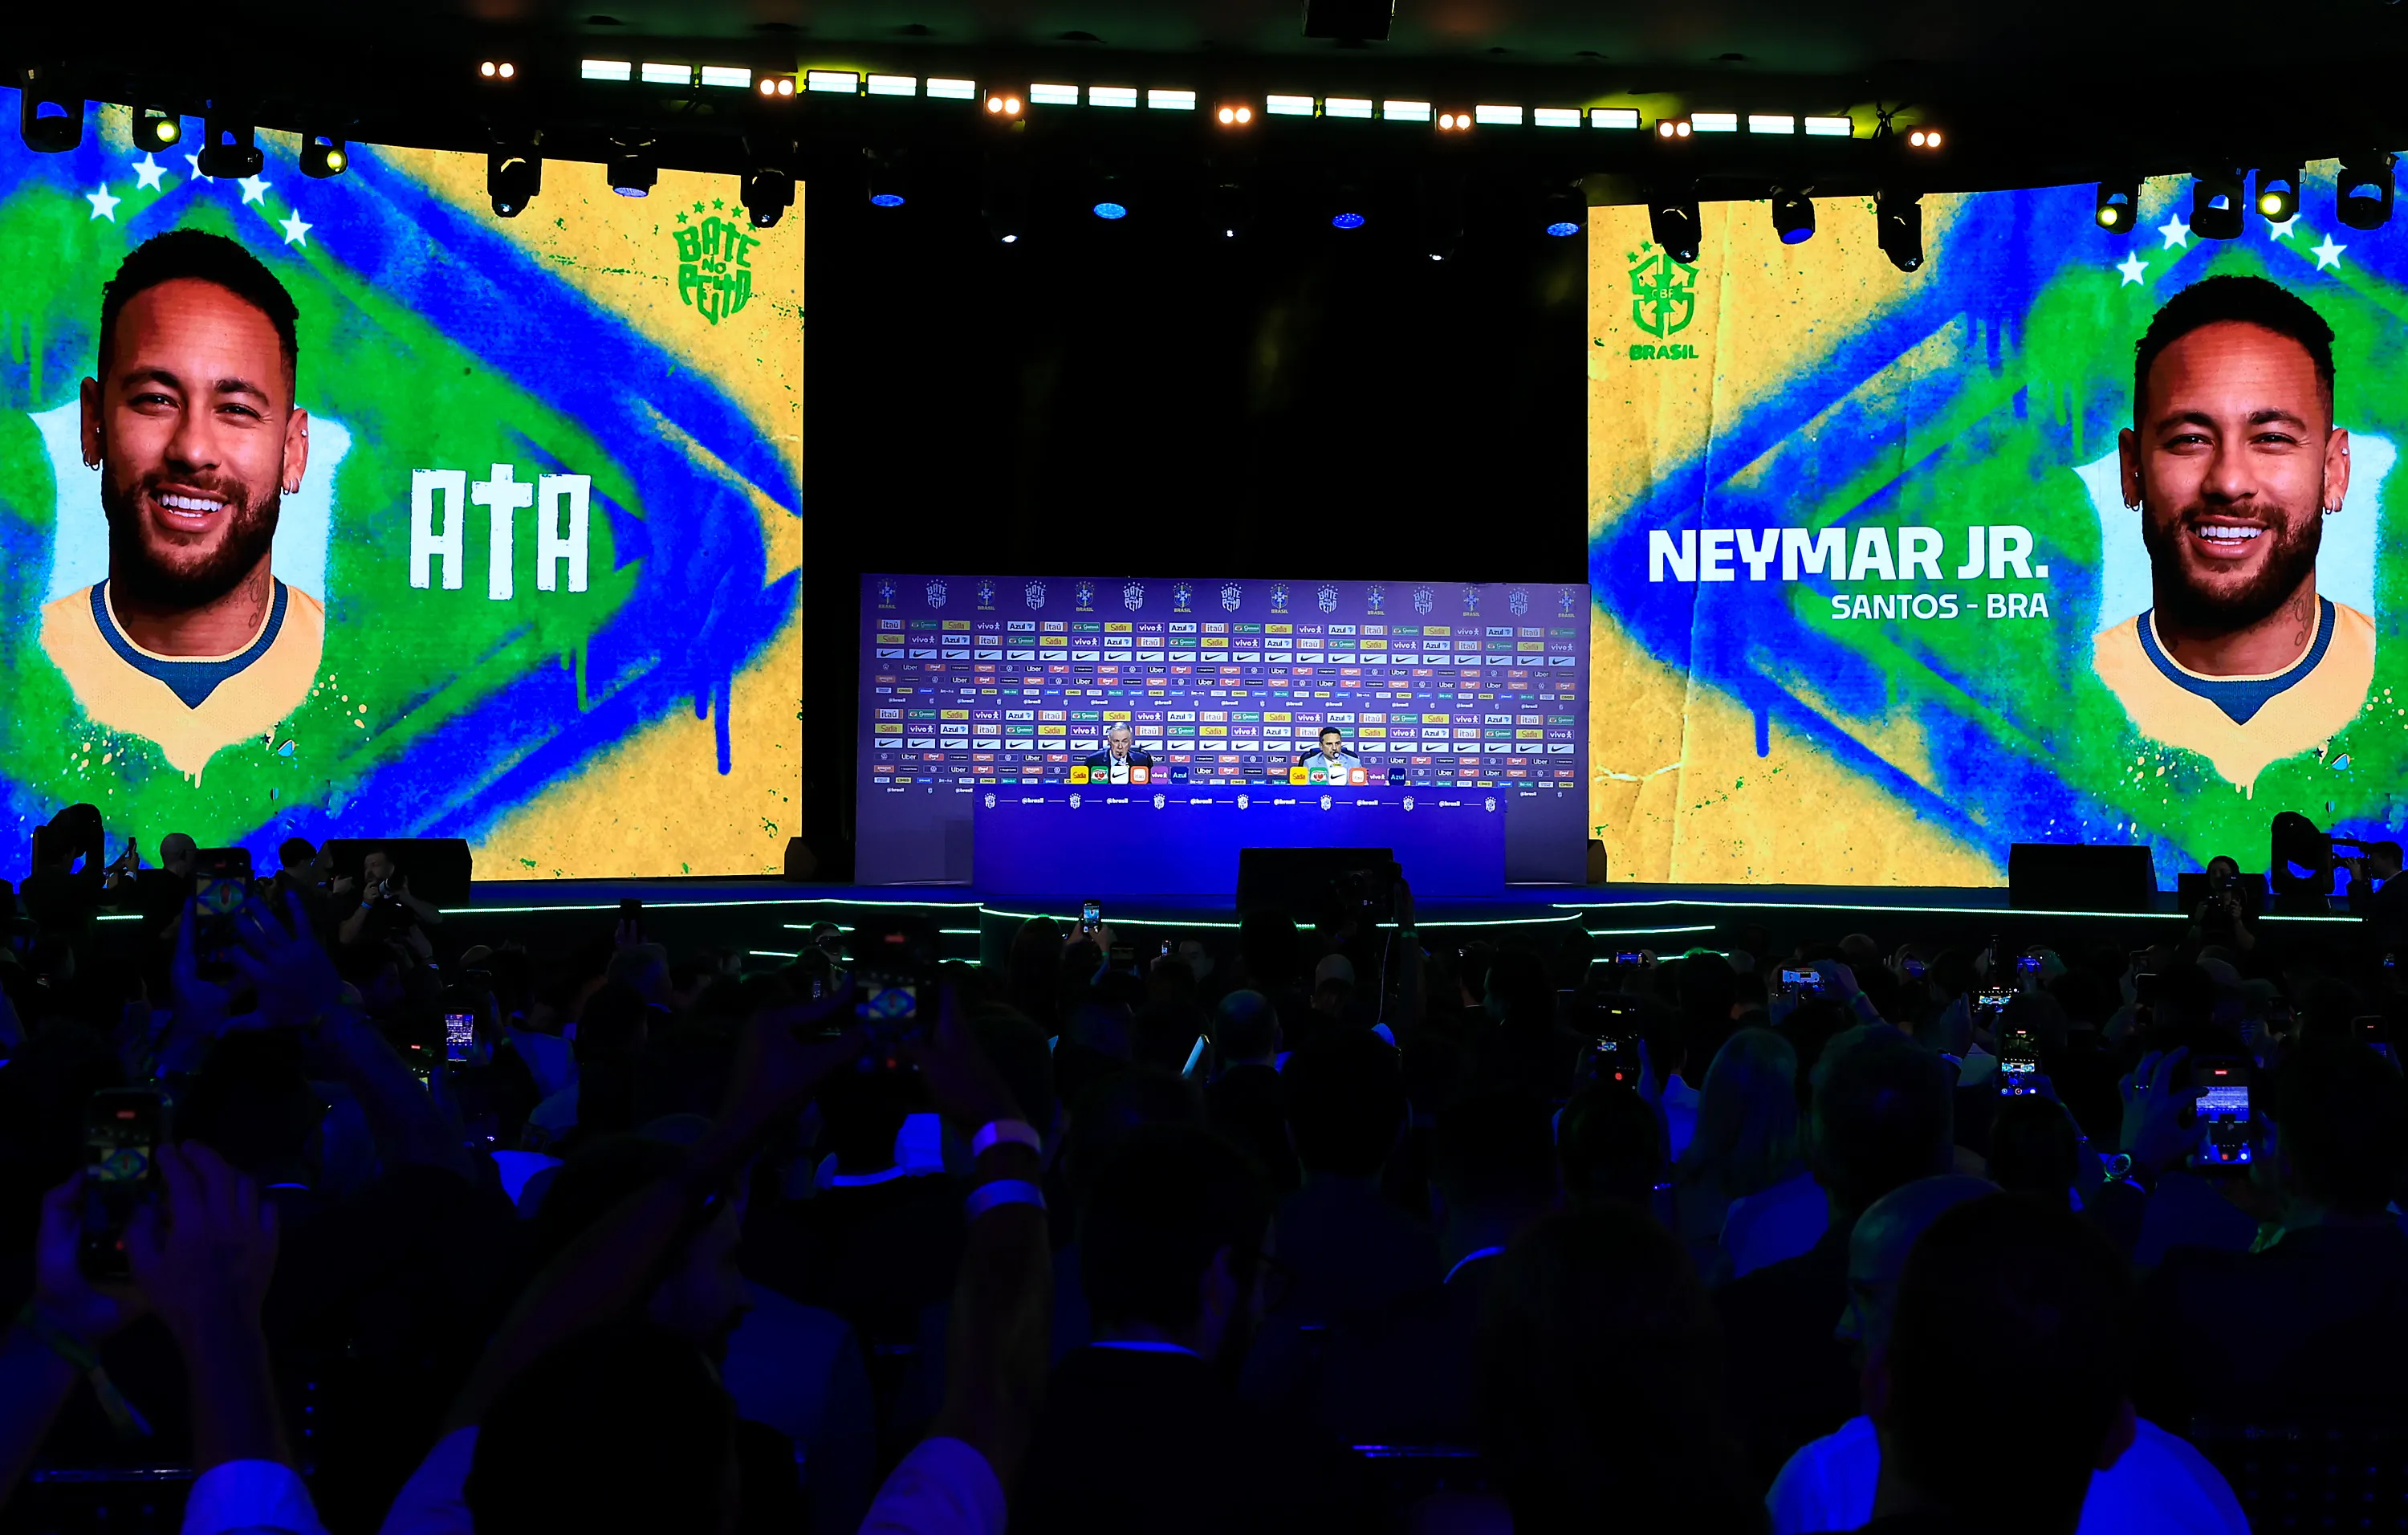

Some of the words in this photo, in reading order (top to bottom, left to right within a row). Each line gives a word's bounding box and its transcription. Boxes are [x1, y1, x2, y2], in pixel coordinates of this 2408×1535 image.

[673, 216, 760, 267] BATE
[702, 254, 726, 274] NO
[678, 263, 751, 325] PEITO
[1629, 344, 1699, 360] BRASIL
[409, 462, 592, 601] ATA
[1649, 527, 1943, 583] NEYMAR
[1957, 525, 2049, 580] JR.
[1831, 594, 1958, 620] SANTOS
[1987, 593, 2048, 618] BRA
